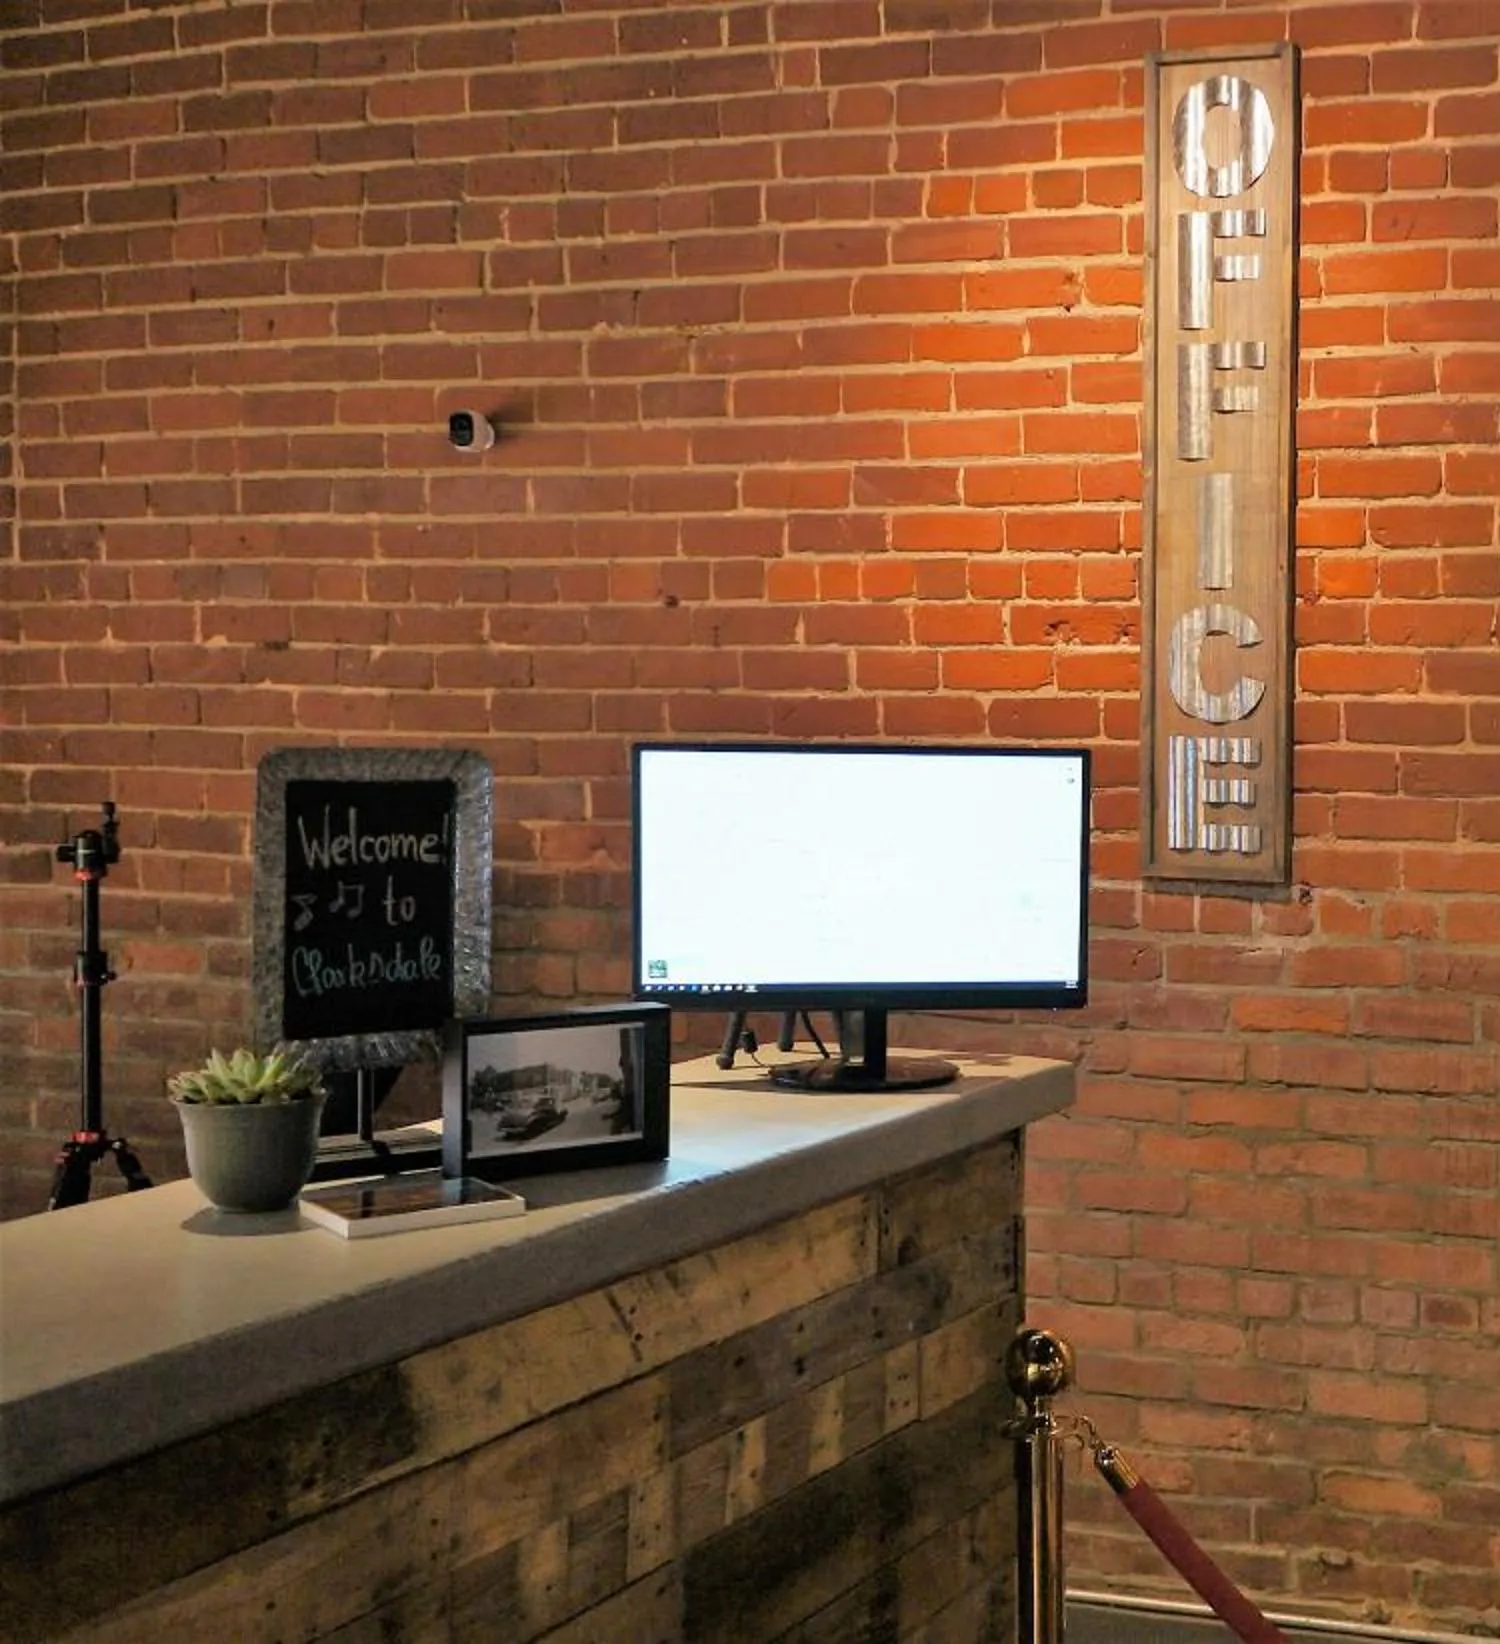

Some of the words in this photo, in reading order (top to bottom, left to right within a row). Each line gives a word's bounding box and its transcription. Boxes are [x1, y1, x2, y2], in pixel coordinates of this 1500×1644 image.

[1168, 73, 1274, 853] OFFICE
[297, 803, 450, 870] Welcome!
[383, 874, 417, 927] to
[291, 934, 442, 998] Clarksdale
